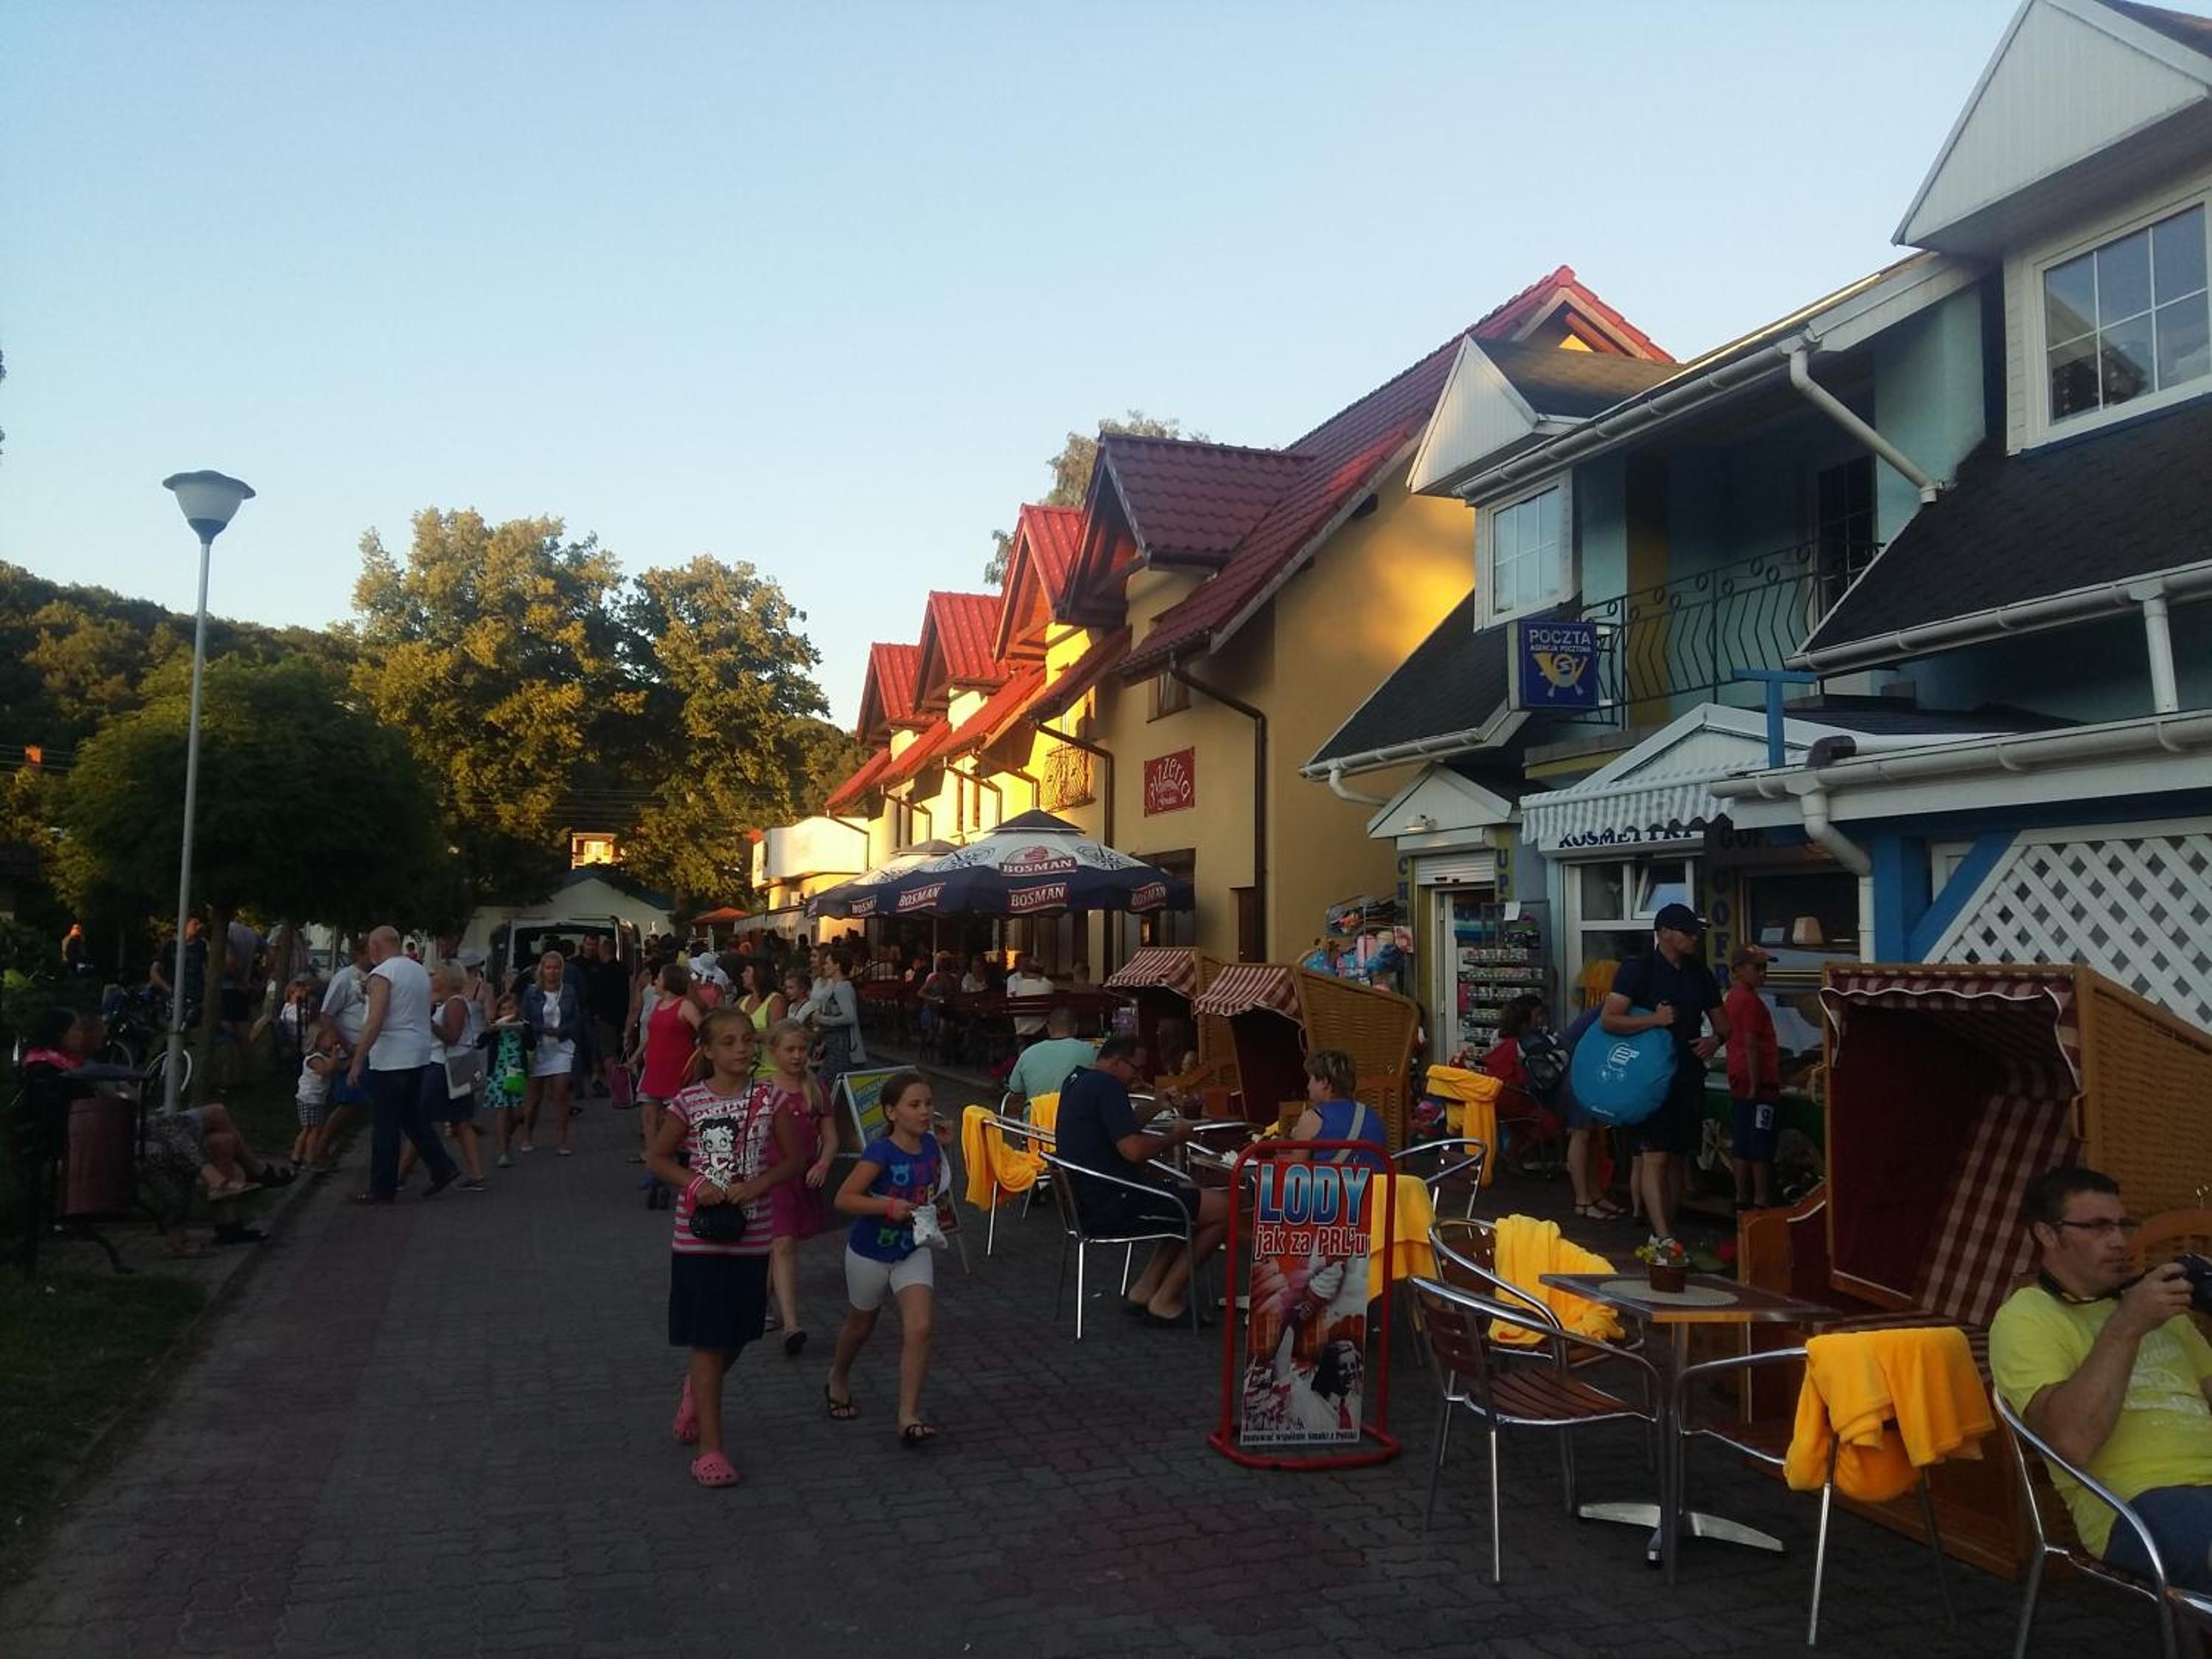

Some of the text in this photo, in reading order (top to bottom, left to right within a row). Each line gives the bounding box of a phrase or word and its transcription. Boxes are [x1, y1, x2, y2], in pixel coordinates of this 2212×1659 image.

[1529, 630, 1591, 644] POCZTA
[1003, 859, 1073, 874] BOSMAN
[899, 887, 941, 906] BOSMAN
[1011, 887, 1064, 907] BOSMAN
[1258, 1164, 1371, 1226] LODY
[1254, 1225, 1286, 1260] jak
[1290, 1231, 1312, 1256] za
